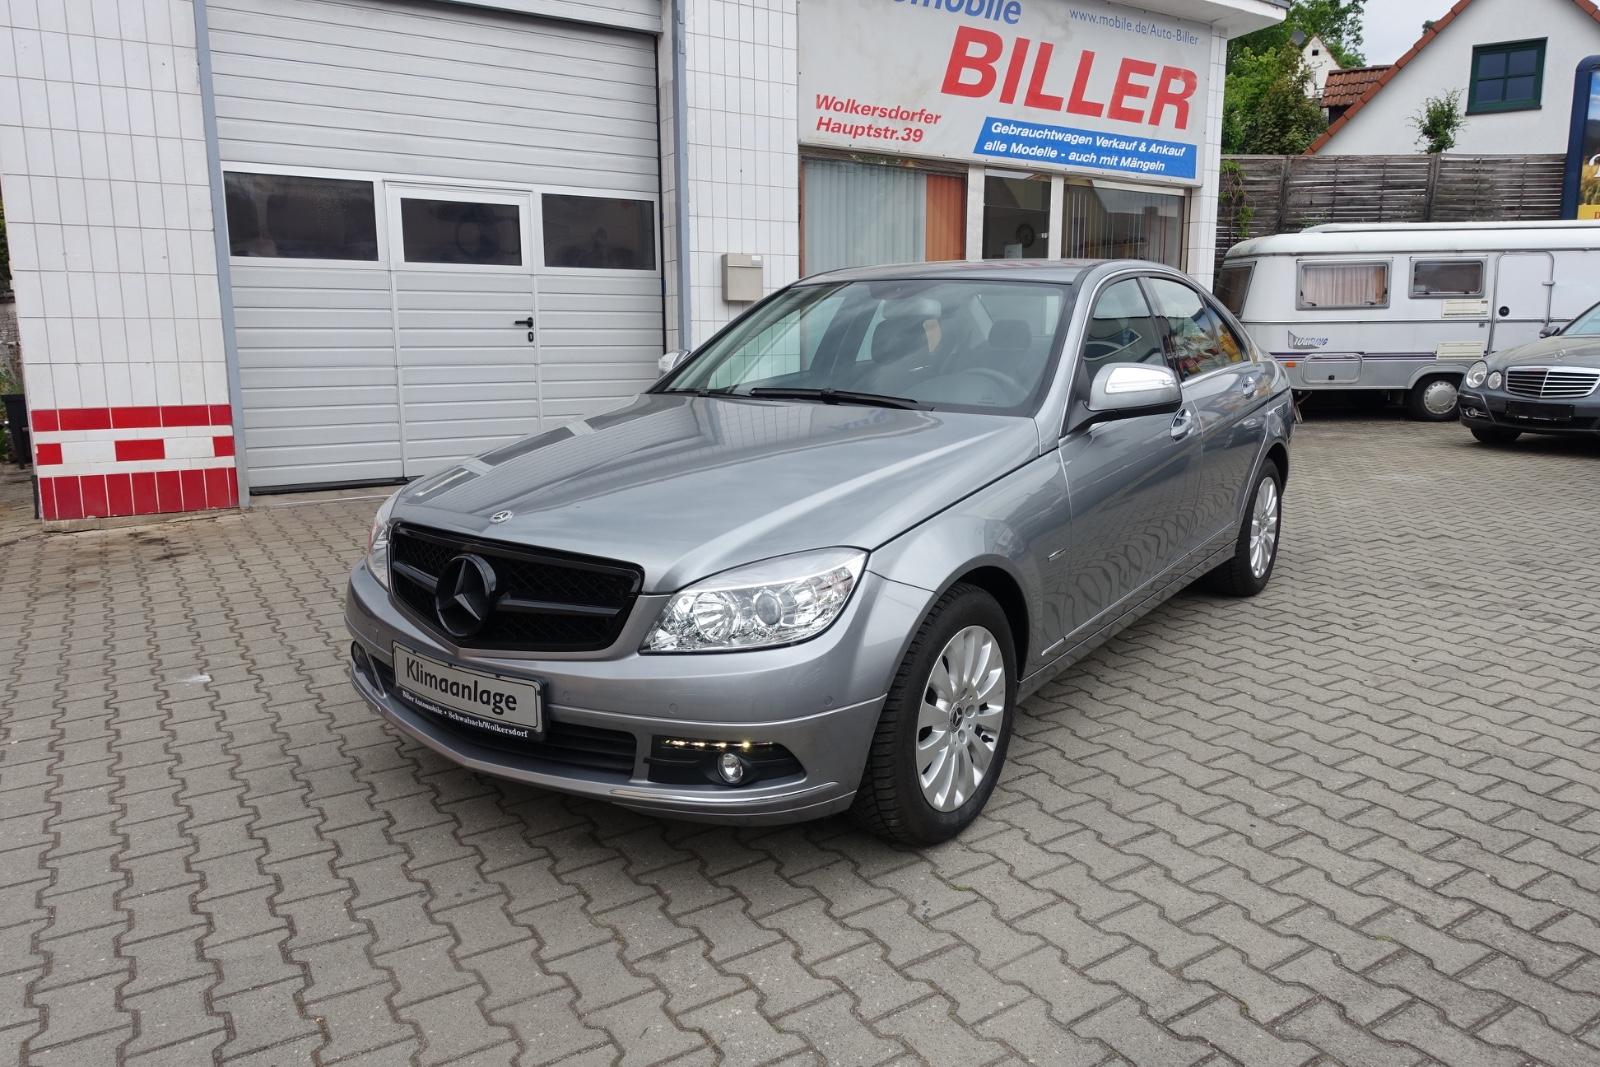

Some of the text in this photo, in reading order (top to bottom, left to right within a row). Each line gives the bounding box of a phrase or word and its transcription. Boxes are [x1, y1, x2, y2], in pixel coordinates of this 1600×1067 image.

[1069, 8, 1199, 46] www.mobile.de/Auto-Biller
[941, 25, 1198, 130] BILLER
[816, 94, 941, 125] Wolkersdorfer
[816, 116, 924, 142] Hauptstr.39
[991, 122, 1187, 157] Gebrauchtwagen Verkauf & Ankauf
[984, 141, 1007, 152] alle
[1010, 143, 1058, 158] Modelle
[1068, 152, 1096, 163] auch
[1099, 155, 1118, 166] mit
[1120, 157, 1165, 171] Mängeln
[406, 657, 517, 715] Klimaanlage
